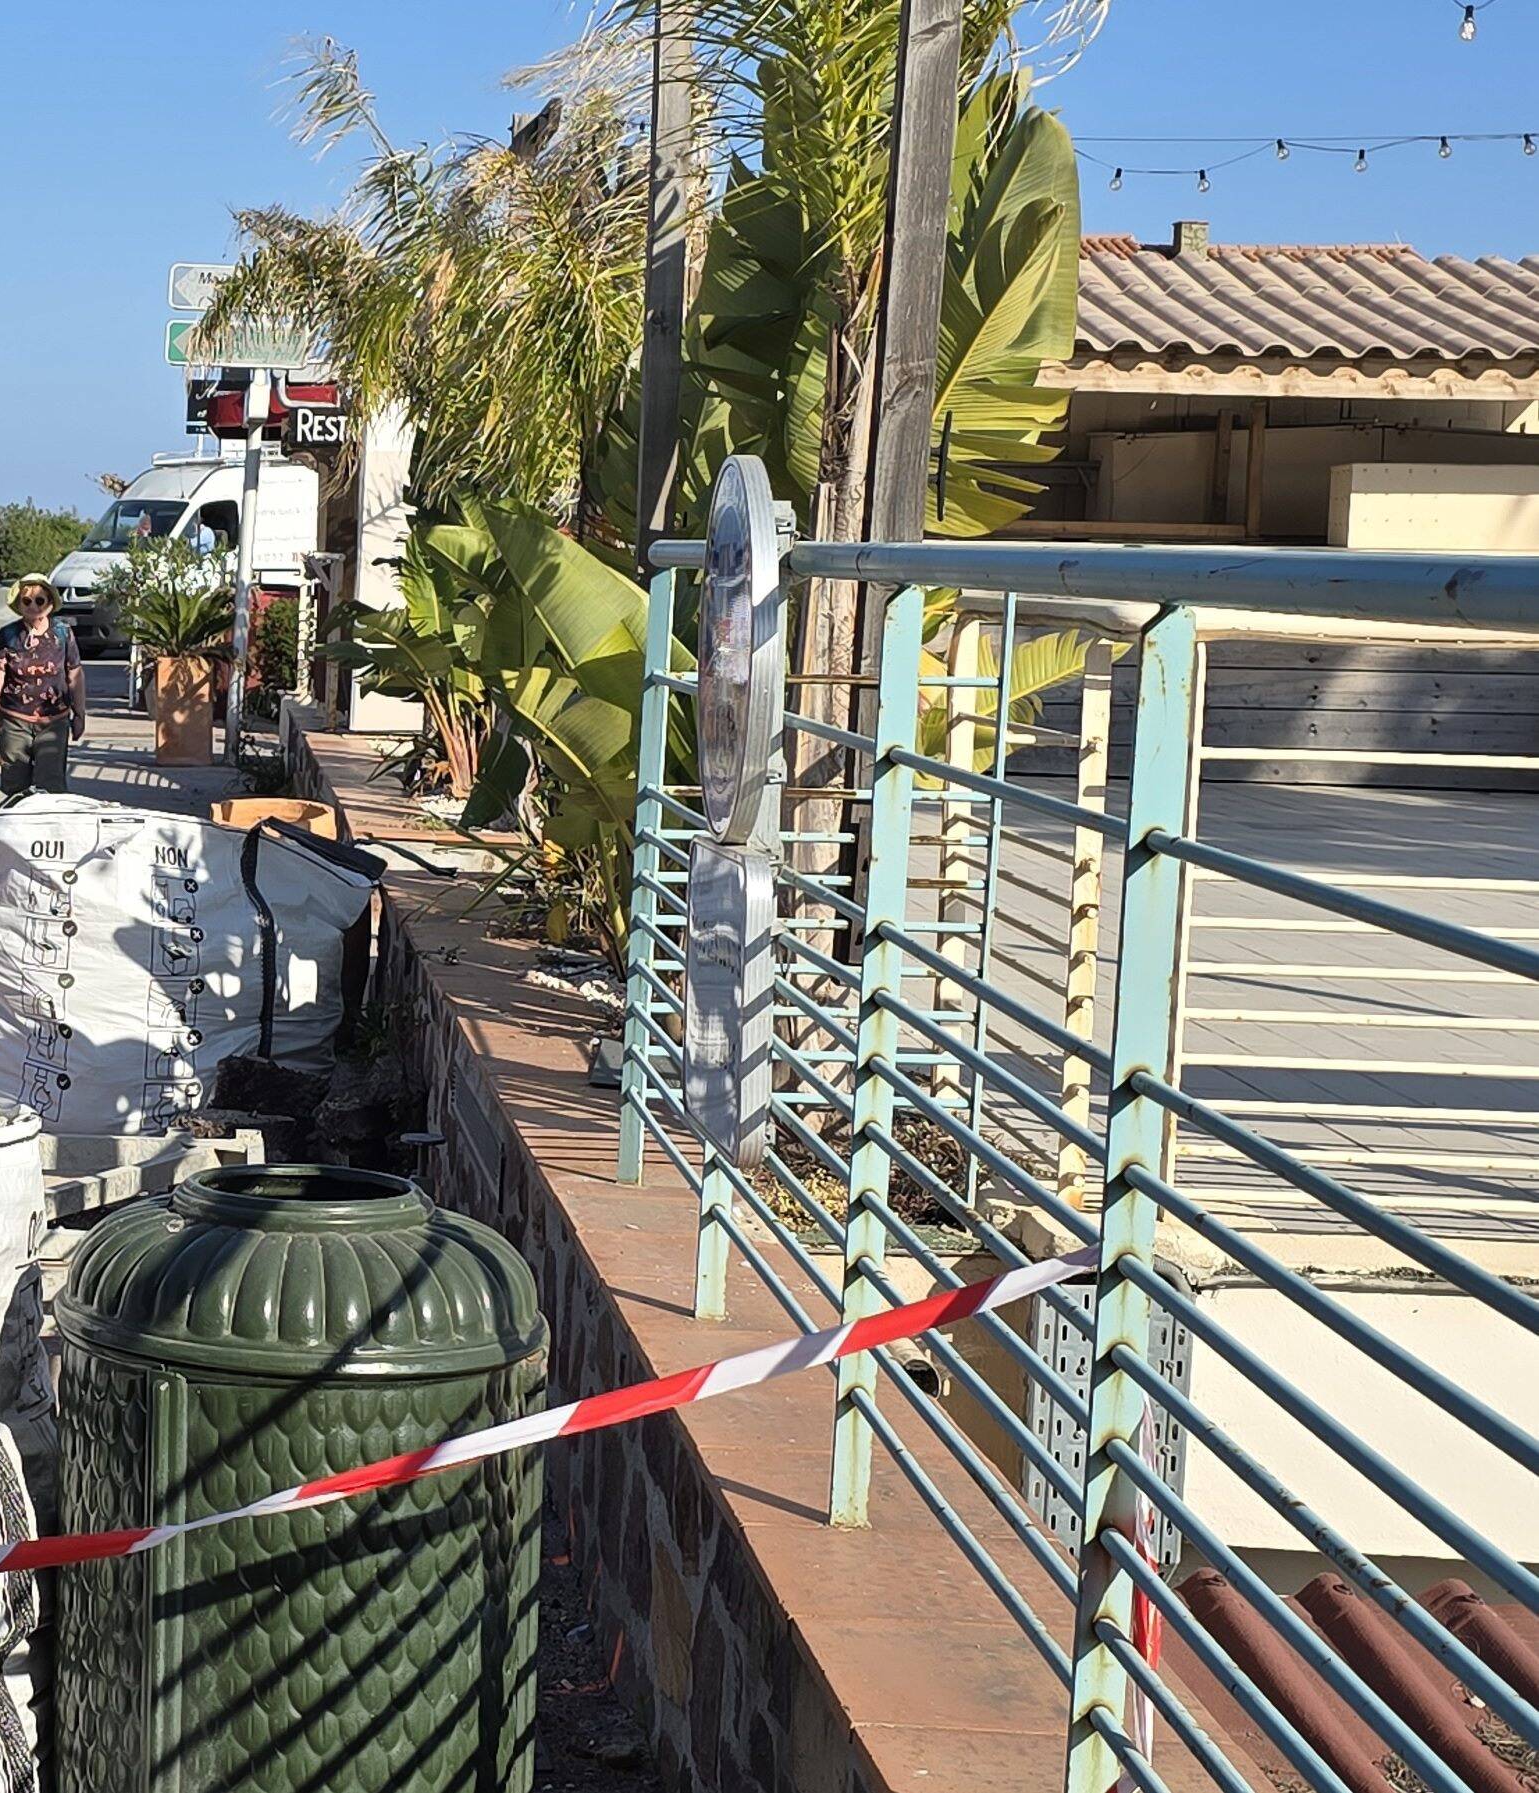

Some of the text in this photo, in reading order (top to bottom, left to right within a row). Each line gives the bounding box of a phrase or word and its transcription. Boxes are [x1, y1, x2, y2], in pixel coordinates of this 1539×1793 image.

[297, 408, 350, 443] REST
[31, 840, 64, 859] OUI
[155, 845, 188, 867] NON
